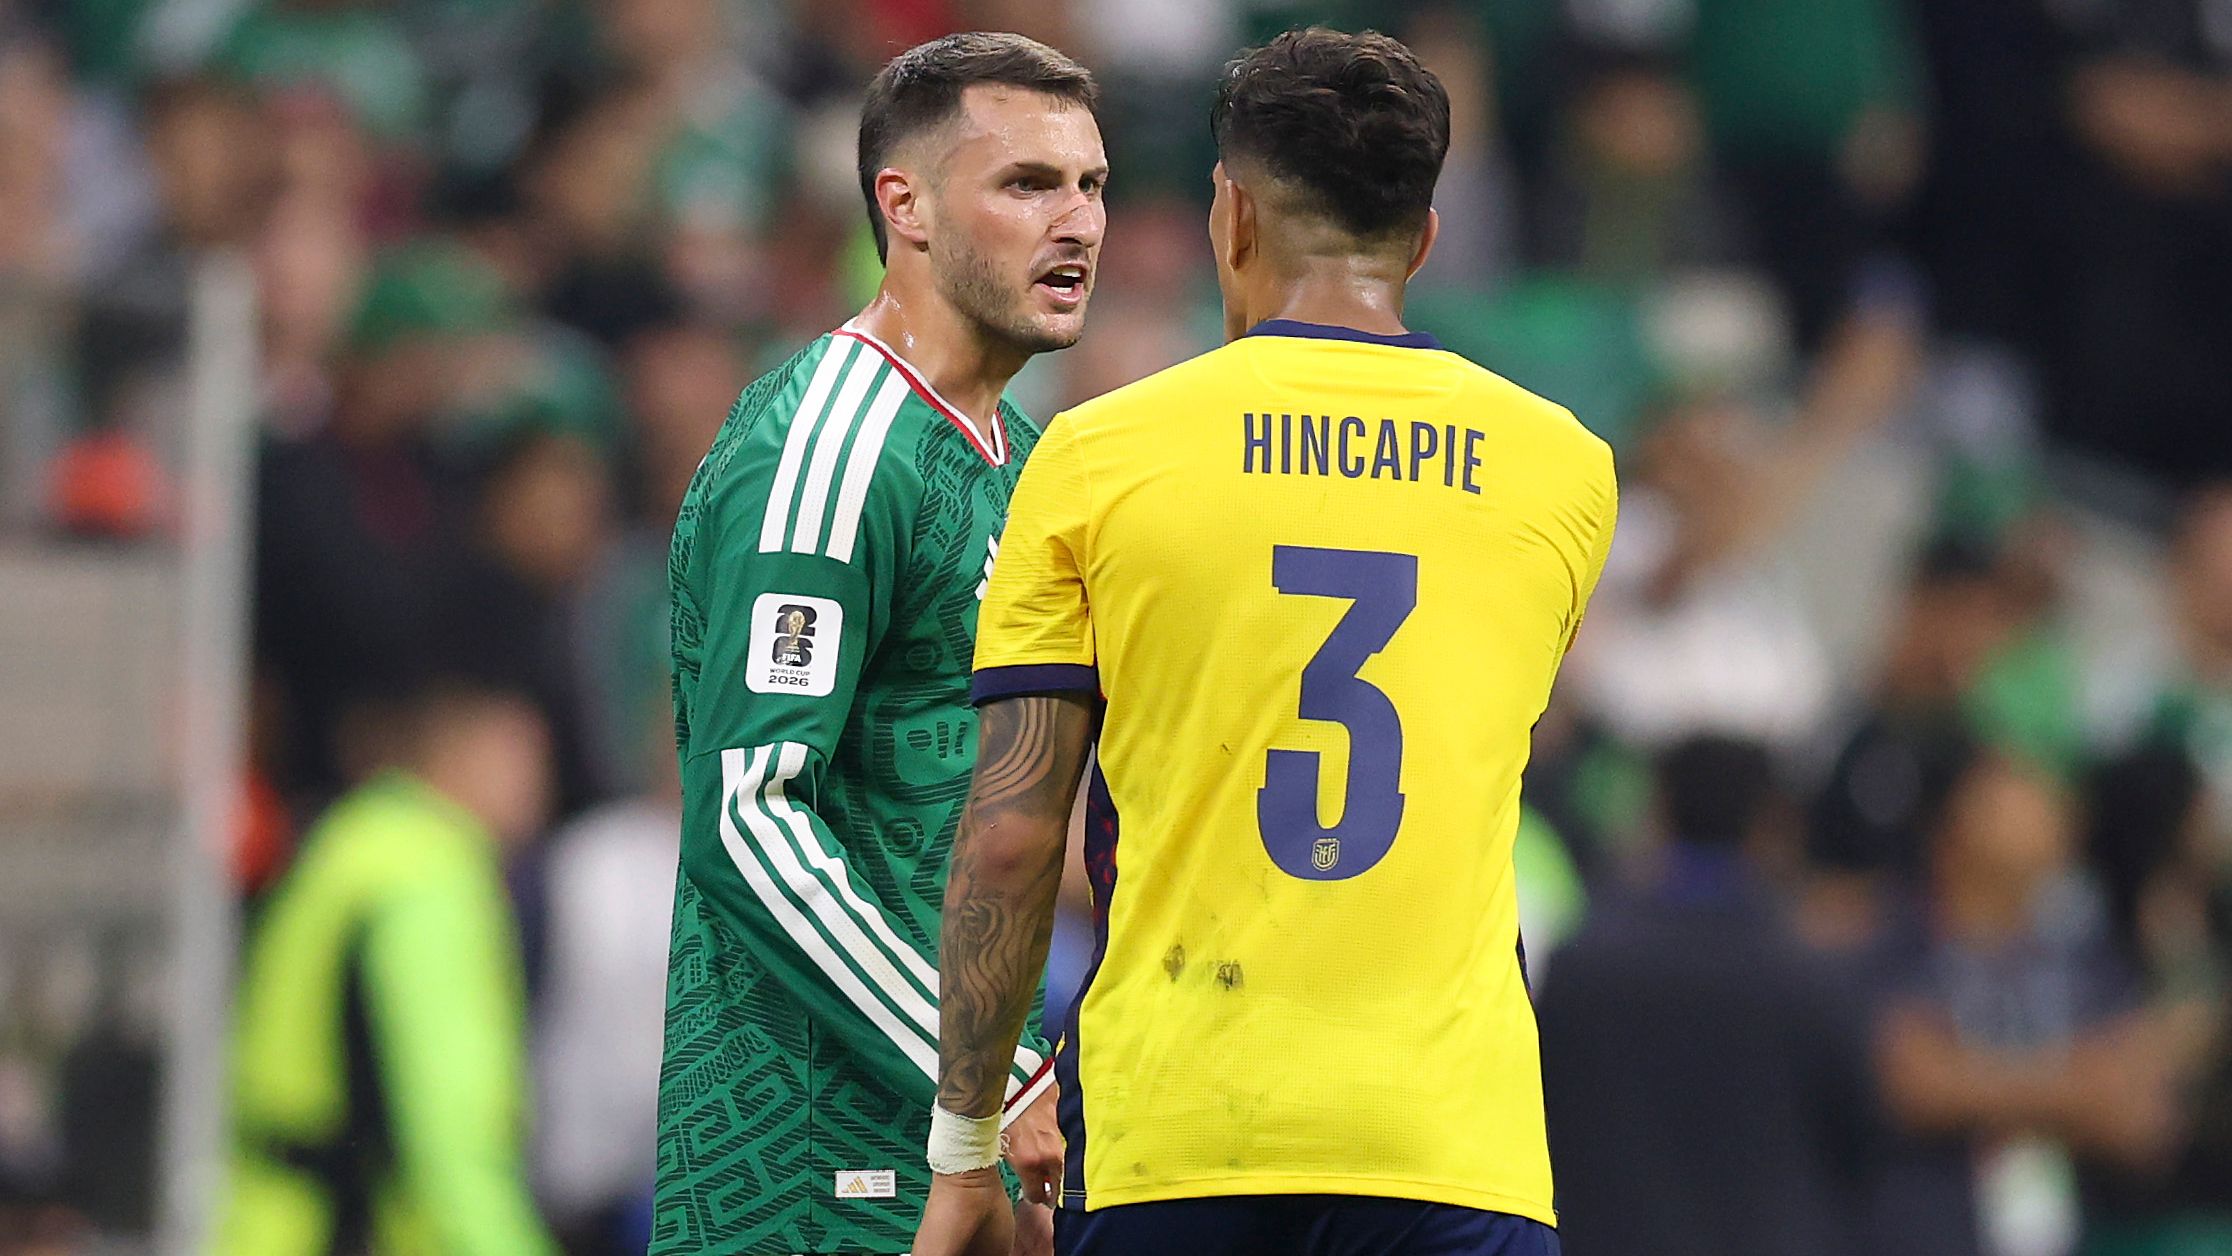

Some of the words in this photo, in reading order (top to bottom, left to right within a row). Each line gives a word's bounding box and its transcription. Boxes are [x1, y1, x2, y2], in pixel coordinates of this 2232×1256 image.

[1243, 413, 1486, 495] HINCAPIE
[768, 675, 809, 686] 2026
[1256, 544, 1419, 882] 3
